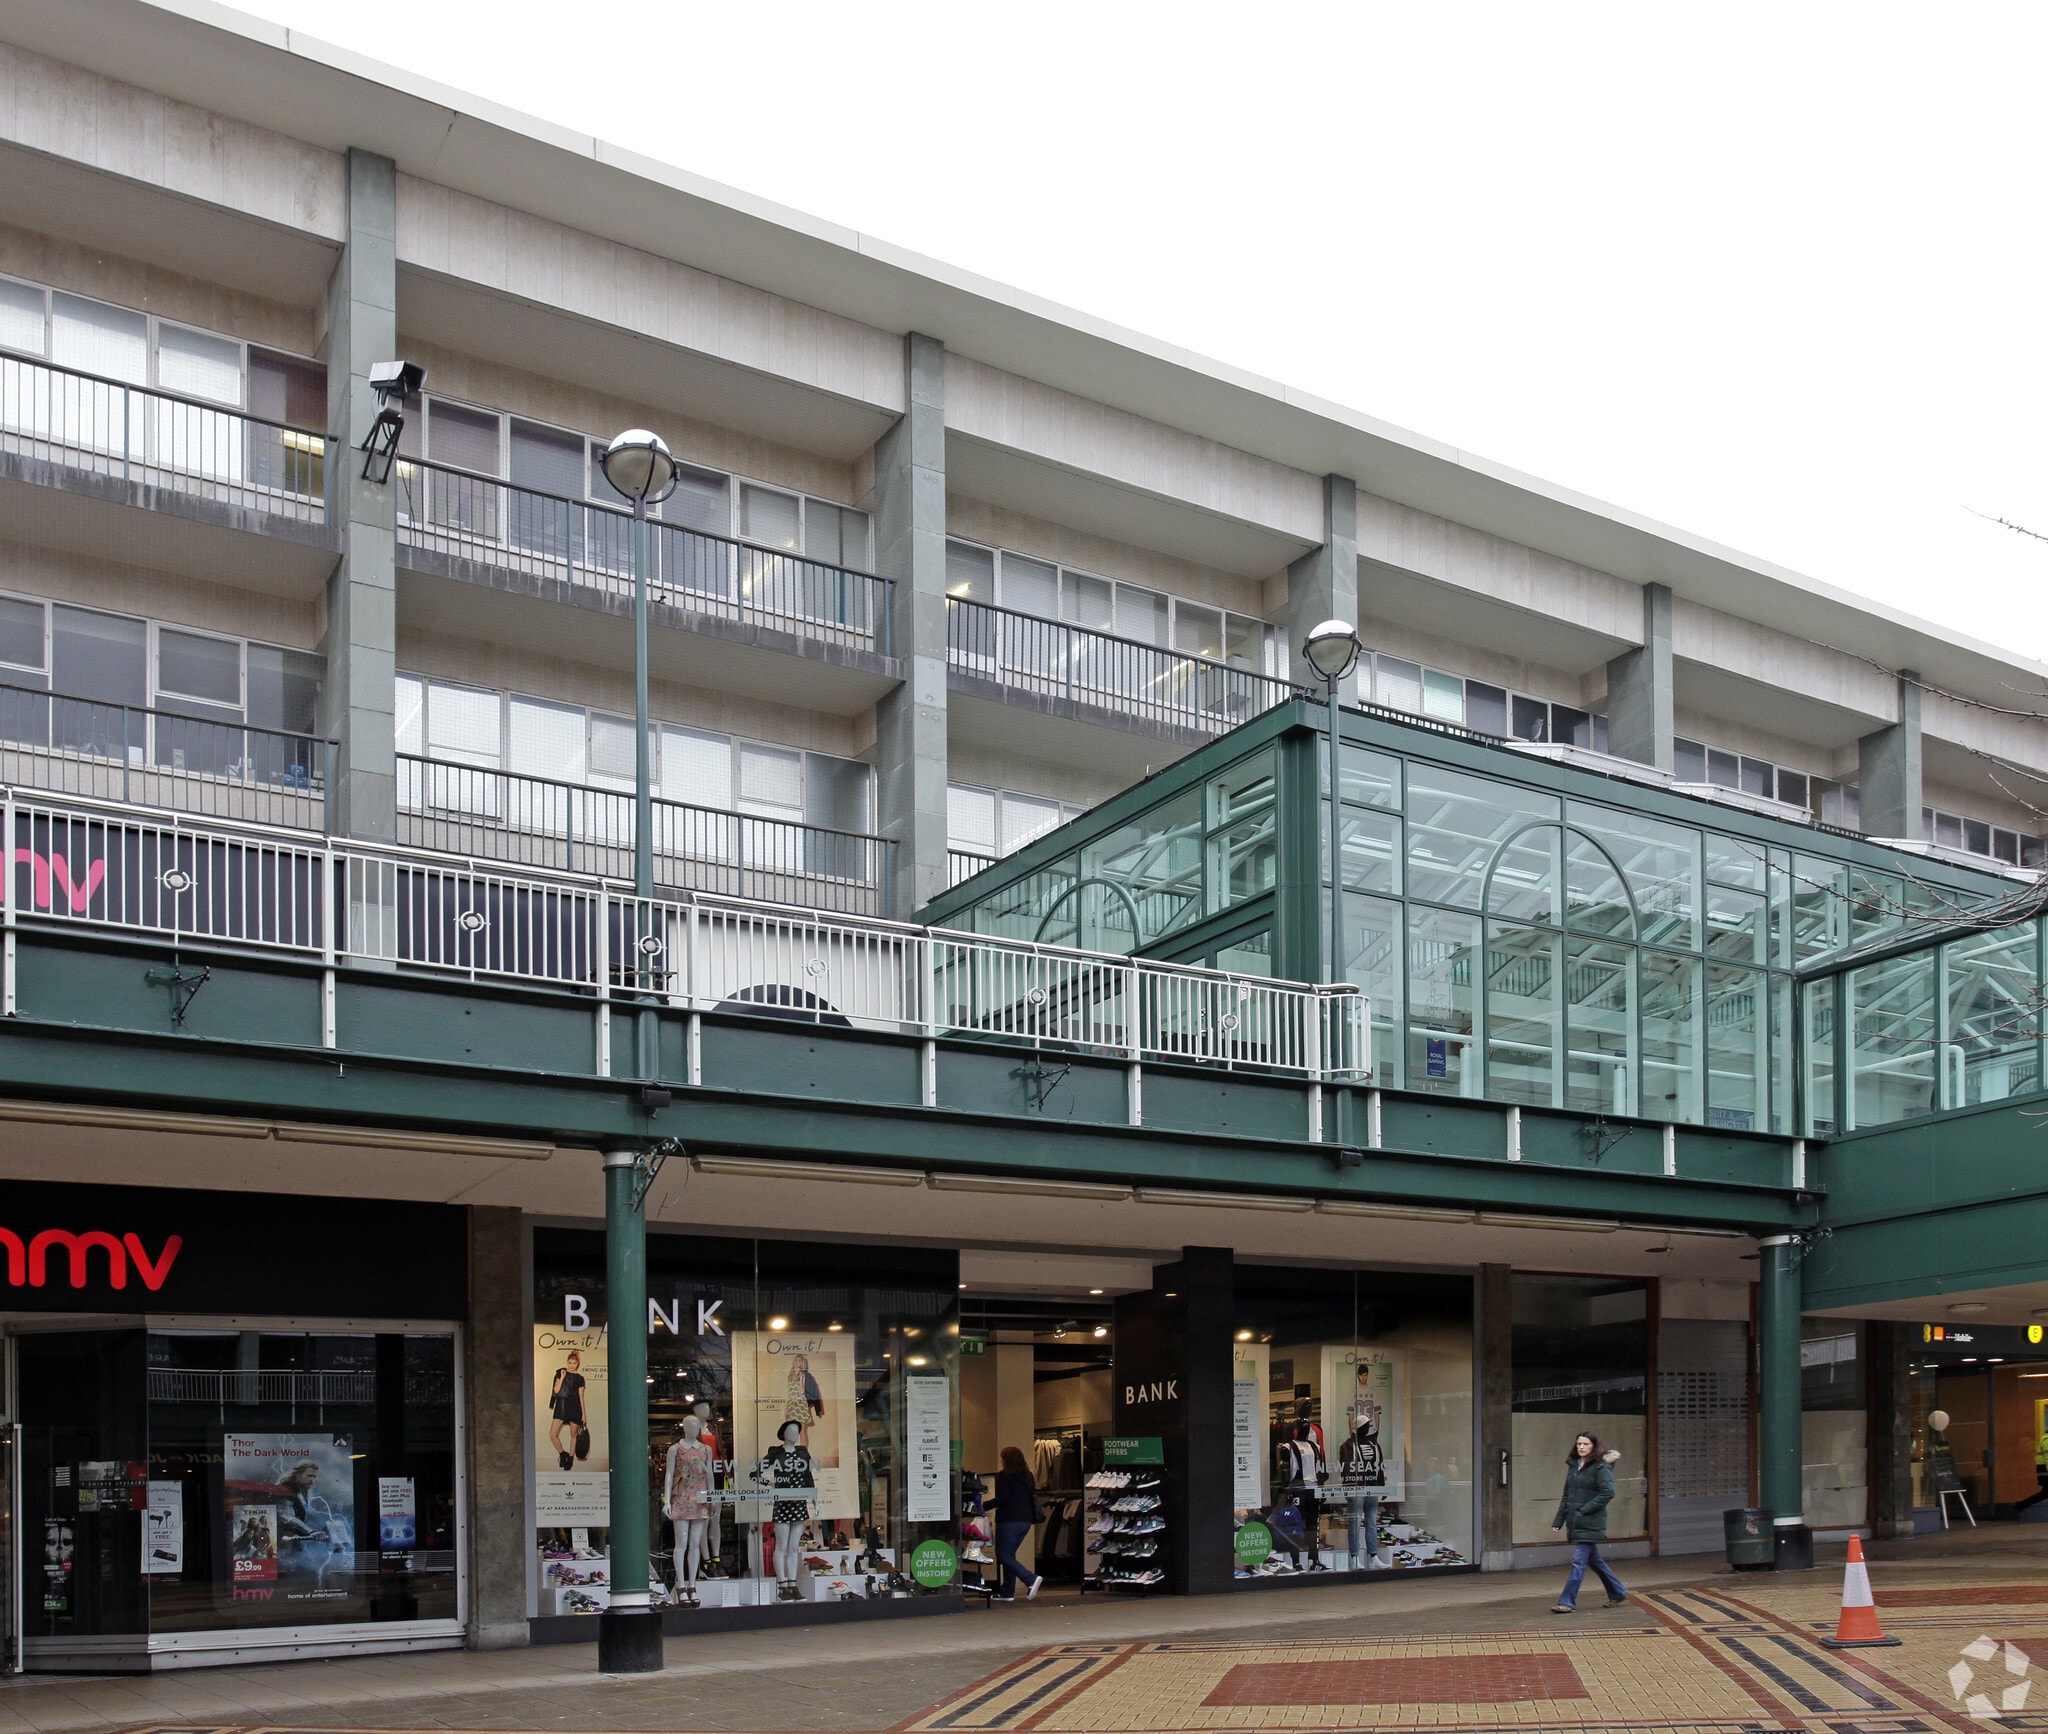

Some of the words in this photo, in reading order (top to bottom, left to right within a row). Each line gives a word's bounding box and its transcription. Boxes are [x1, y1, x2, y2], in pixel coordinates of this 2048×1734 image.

[1709, 1108, 1726, 1118] SUIT
[1710, 1118, 1747, 1129] DESIGNER
[564, 1294, 725, 1336] BNK
[539, 1333, 578, 1349] Own
[767, 1340, 801, 1354] Own
[805, 1338, 824, 1354] it!
[1345, 1352, 1369, 1365] Own
[1126, 1380, 1178, 1405] BANK
[232, 1439, 255, 1447] Thor
[232, 1449, 251, 1457] The
[255, 1449, 278, 1457] Dark
[281, 1449, 310, 1457] World
[700, 1459, 739, 1473] NEW
[752, 1458, 822, 1473] SEASON
[1316, 1462, 1345, 1473] NEW
[1244, 1532, 1264, 1540] NEW
[1240, 1538, 1269, 1548] OFFERS
[922, 1551, 946, 1559] NEW
[1241, 1548, 1268, 1557] INSTORE
[235, 1560, 262, 1572] £9.99
[916, 1559, 952, 1568] OFFERS
[917, 1570, 950, 1578] INSTORE
[233, 1585, 275, 1600] hmv
